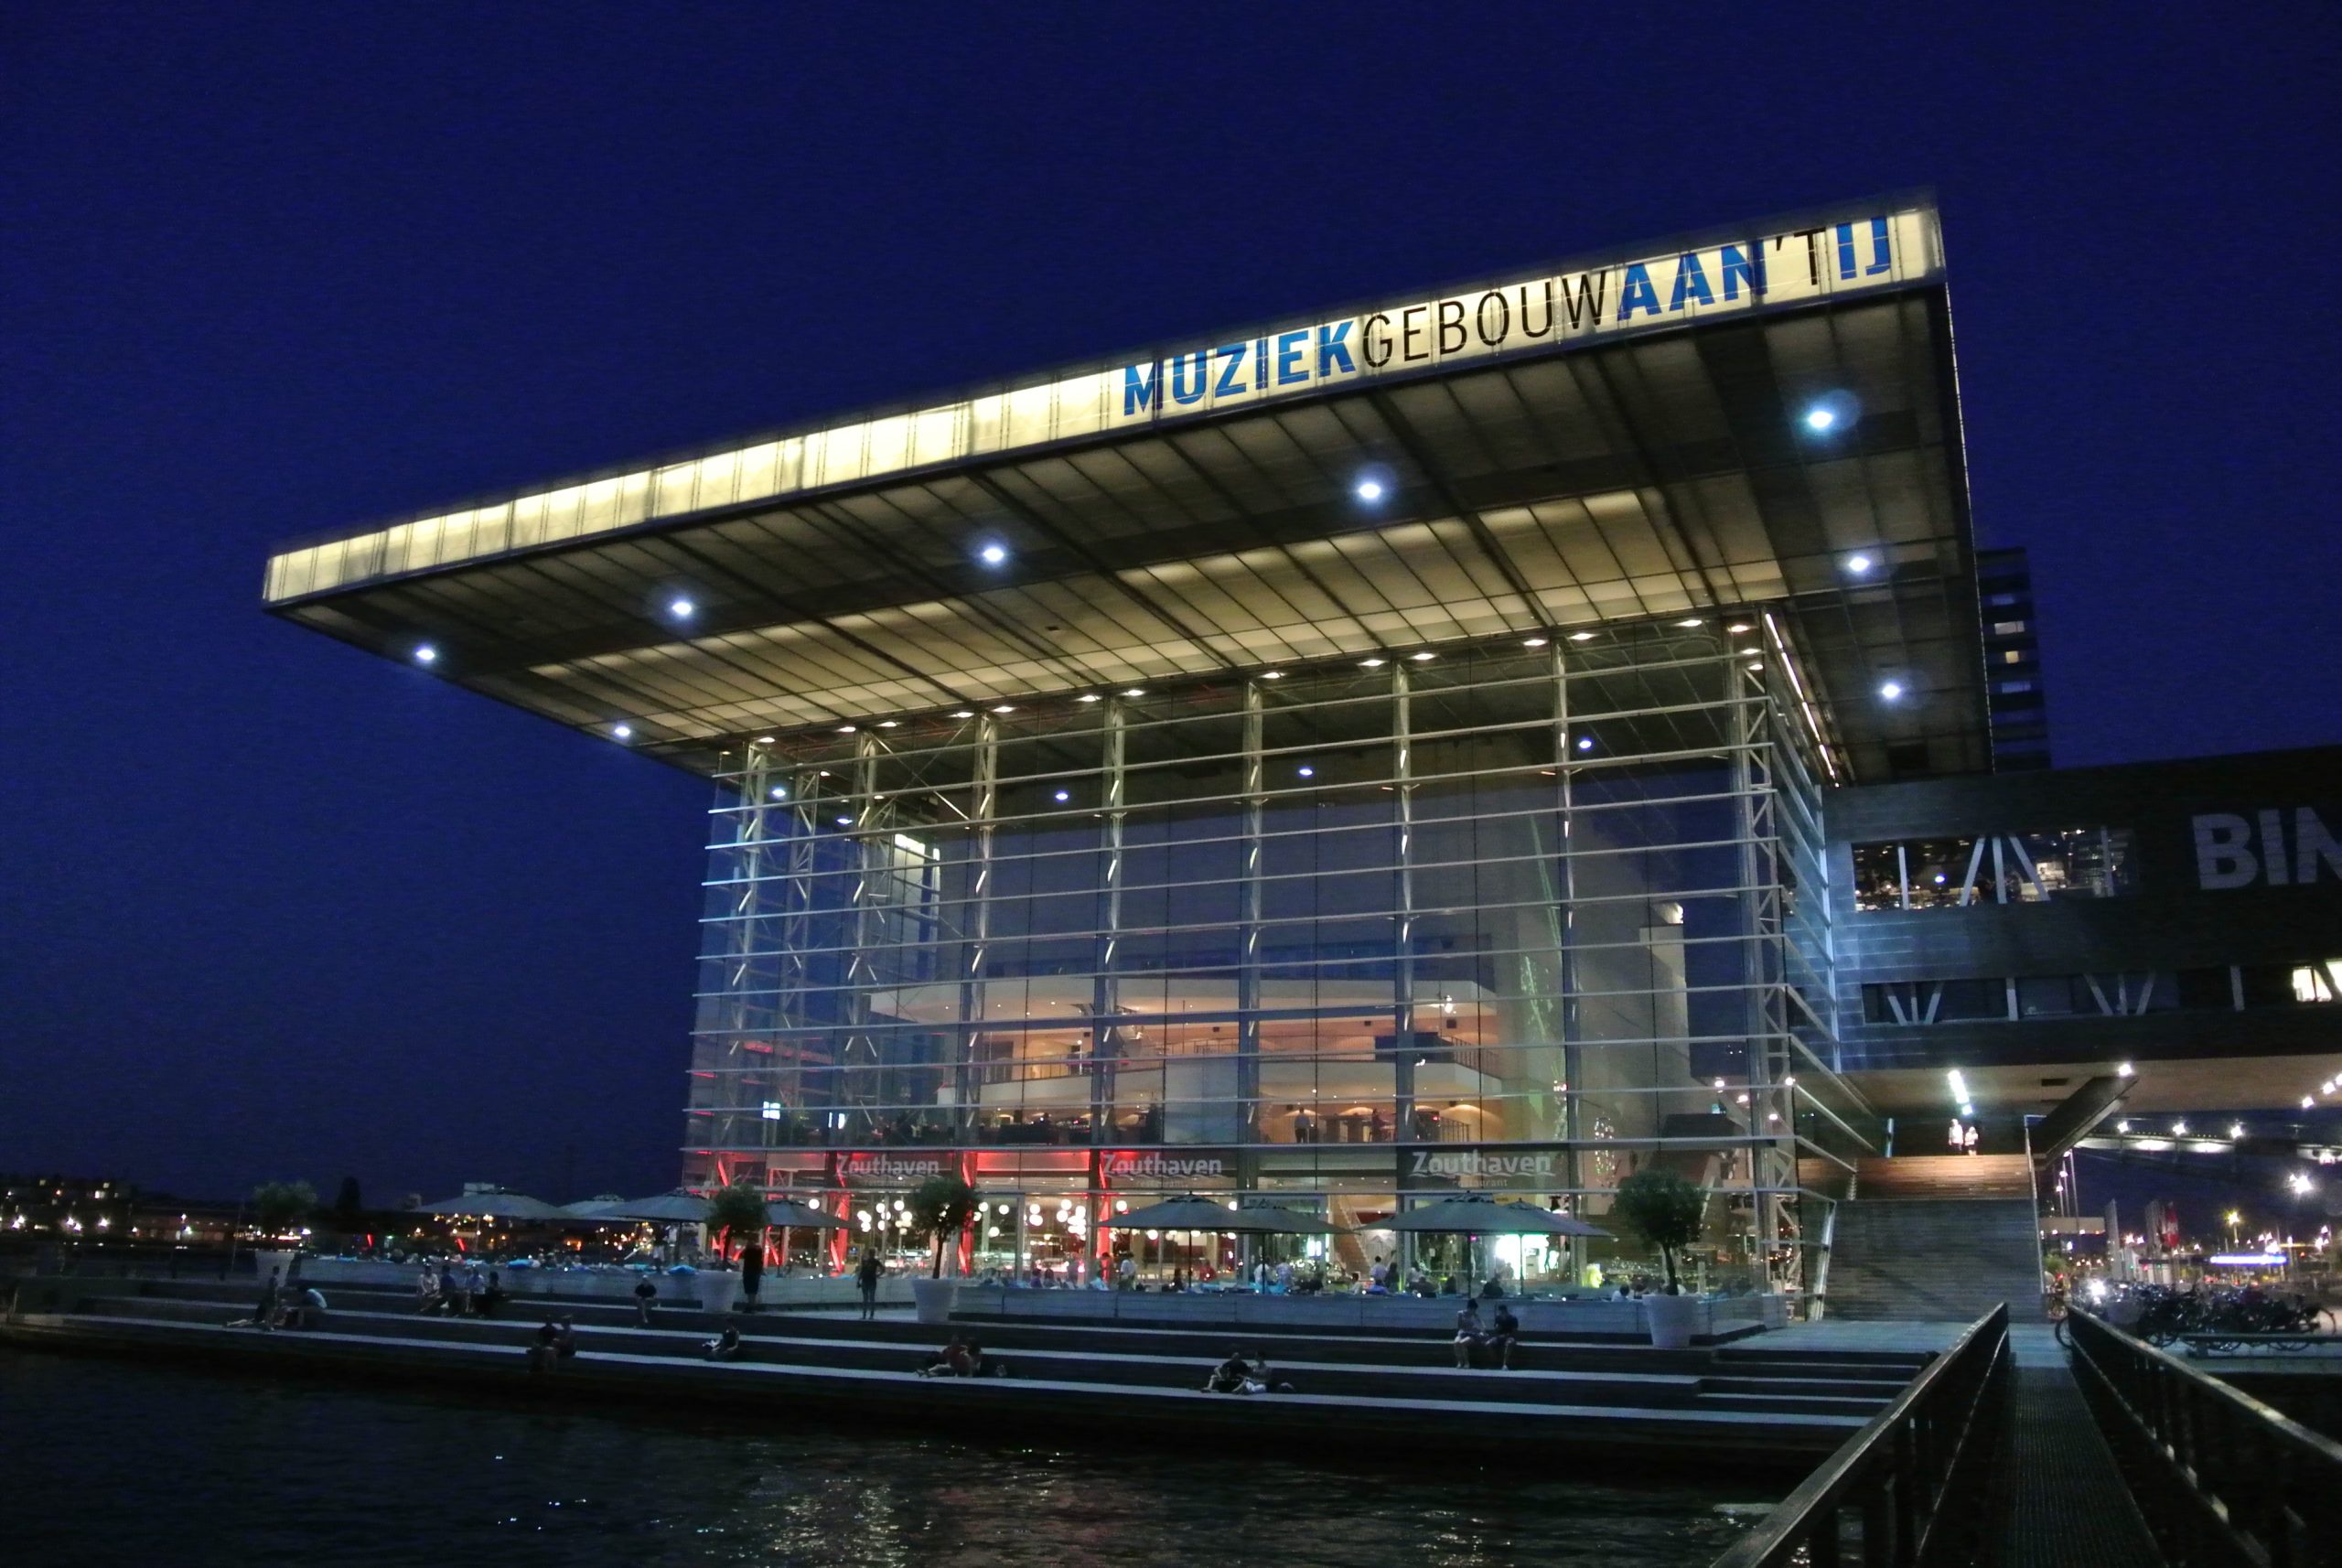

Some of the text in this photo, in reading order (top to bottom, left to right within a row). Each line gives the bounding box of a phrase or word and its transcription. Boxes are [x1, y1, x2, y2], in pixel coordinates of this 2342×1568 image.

[836, 1153, 939, 1176] Zouthaven
[1102, 1152, 1222, 1176] Zouthaven
[1412, 1149, 1551, 1174] Zouthaven
[1452, 1177, 1508, 1187] retaurant
